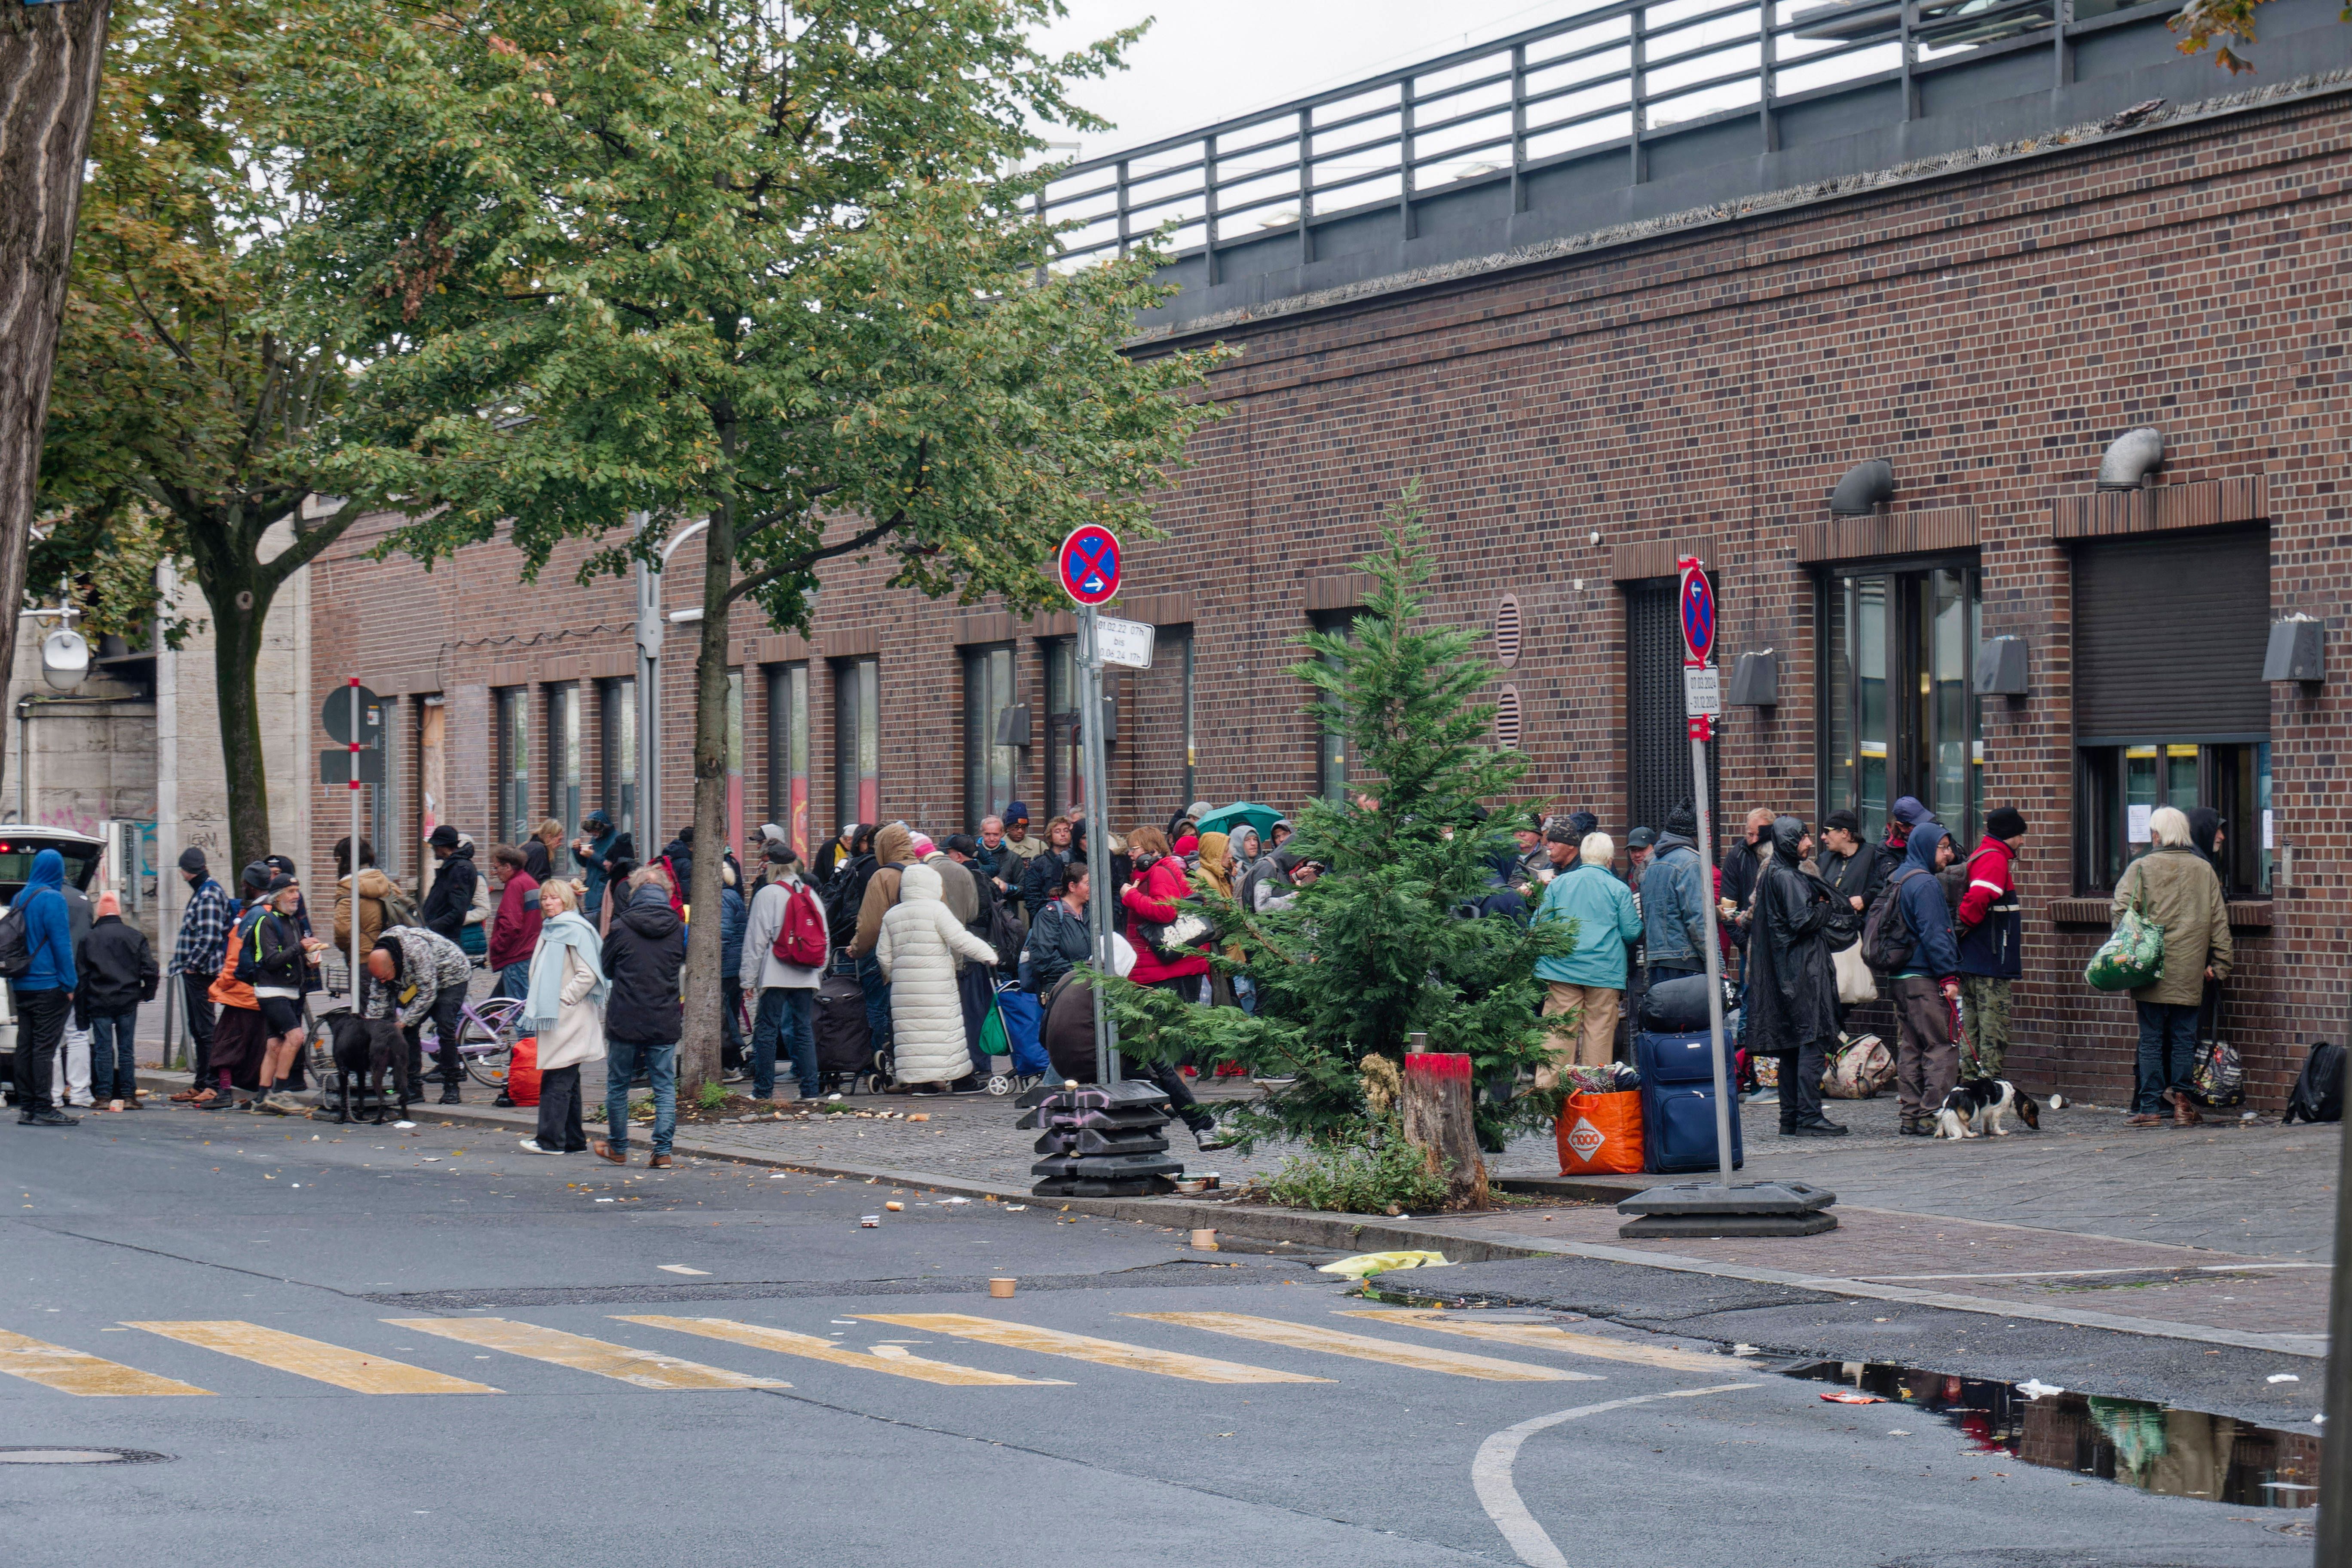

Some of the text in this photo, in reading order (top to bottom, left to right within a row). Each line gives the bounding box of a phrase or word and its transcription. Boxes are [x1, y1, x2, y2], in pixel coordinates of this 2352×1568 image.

[1098, 621, 1144, 636] 01.02.22 07h
[1114, 637, 1125, 646] bis
[1099, 648, 1141, 662] 0.06.24 17h
